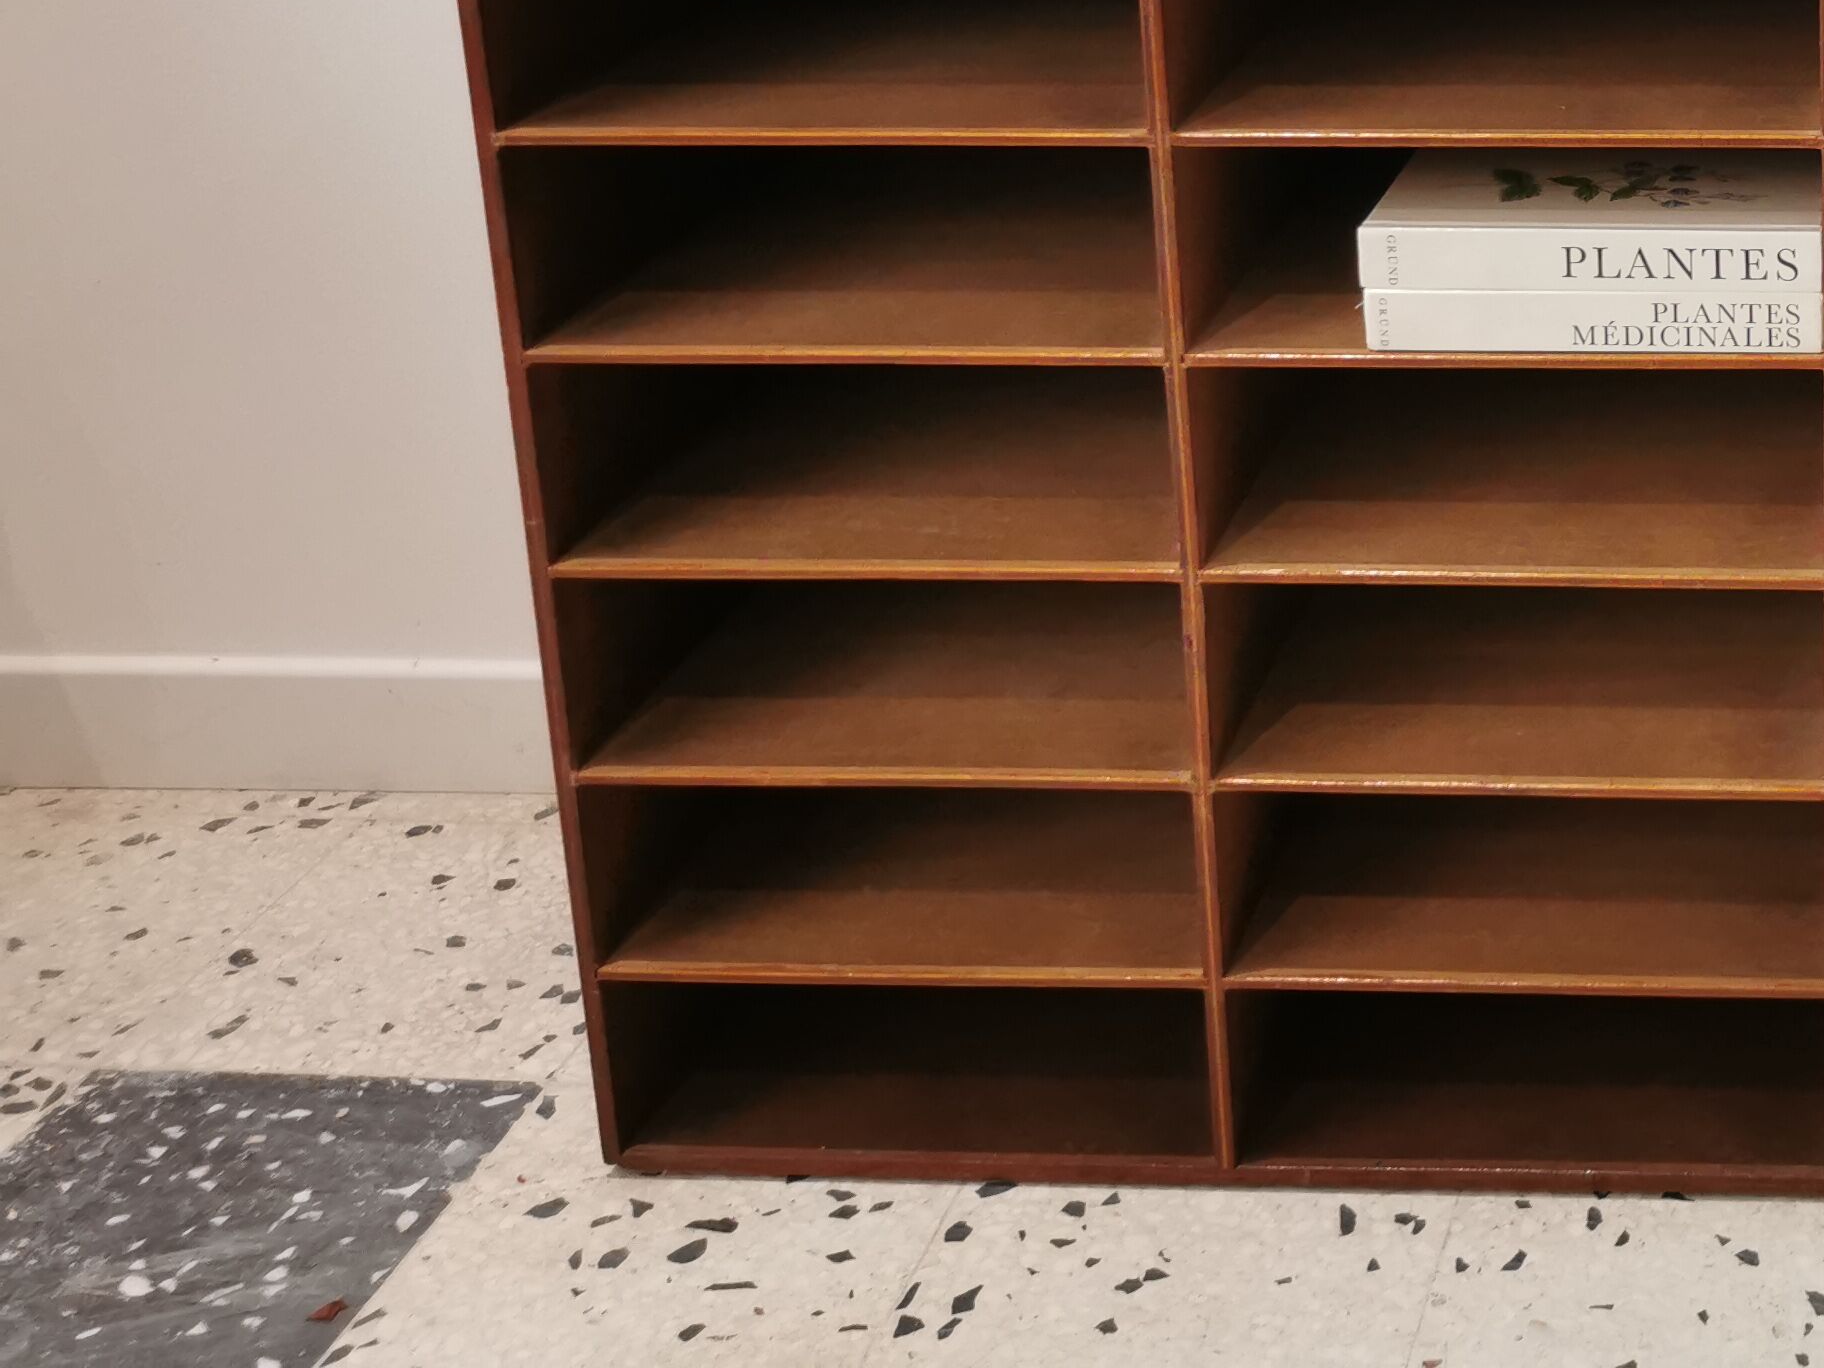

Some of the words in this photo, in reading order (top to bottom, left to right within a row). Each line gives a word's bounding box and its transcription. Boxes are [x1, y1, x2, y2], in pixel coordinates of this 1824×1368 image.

[1560, 245, 1800, 282] PLANTES
[1651, 302, 1801, 325] PLANTES
[1571, 320, 1801, 348] MÉDICINALES
